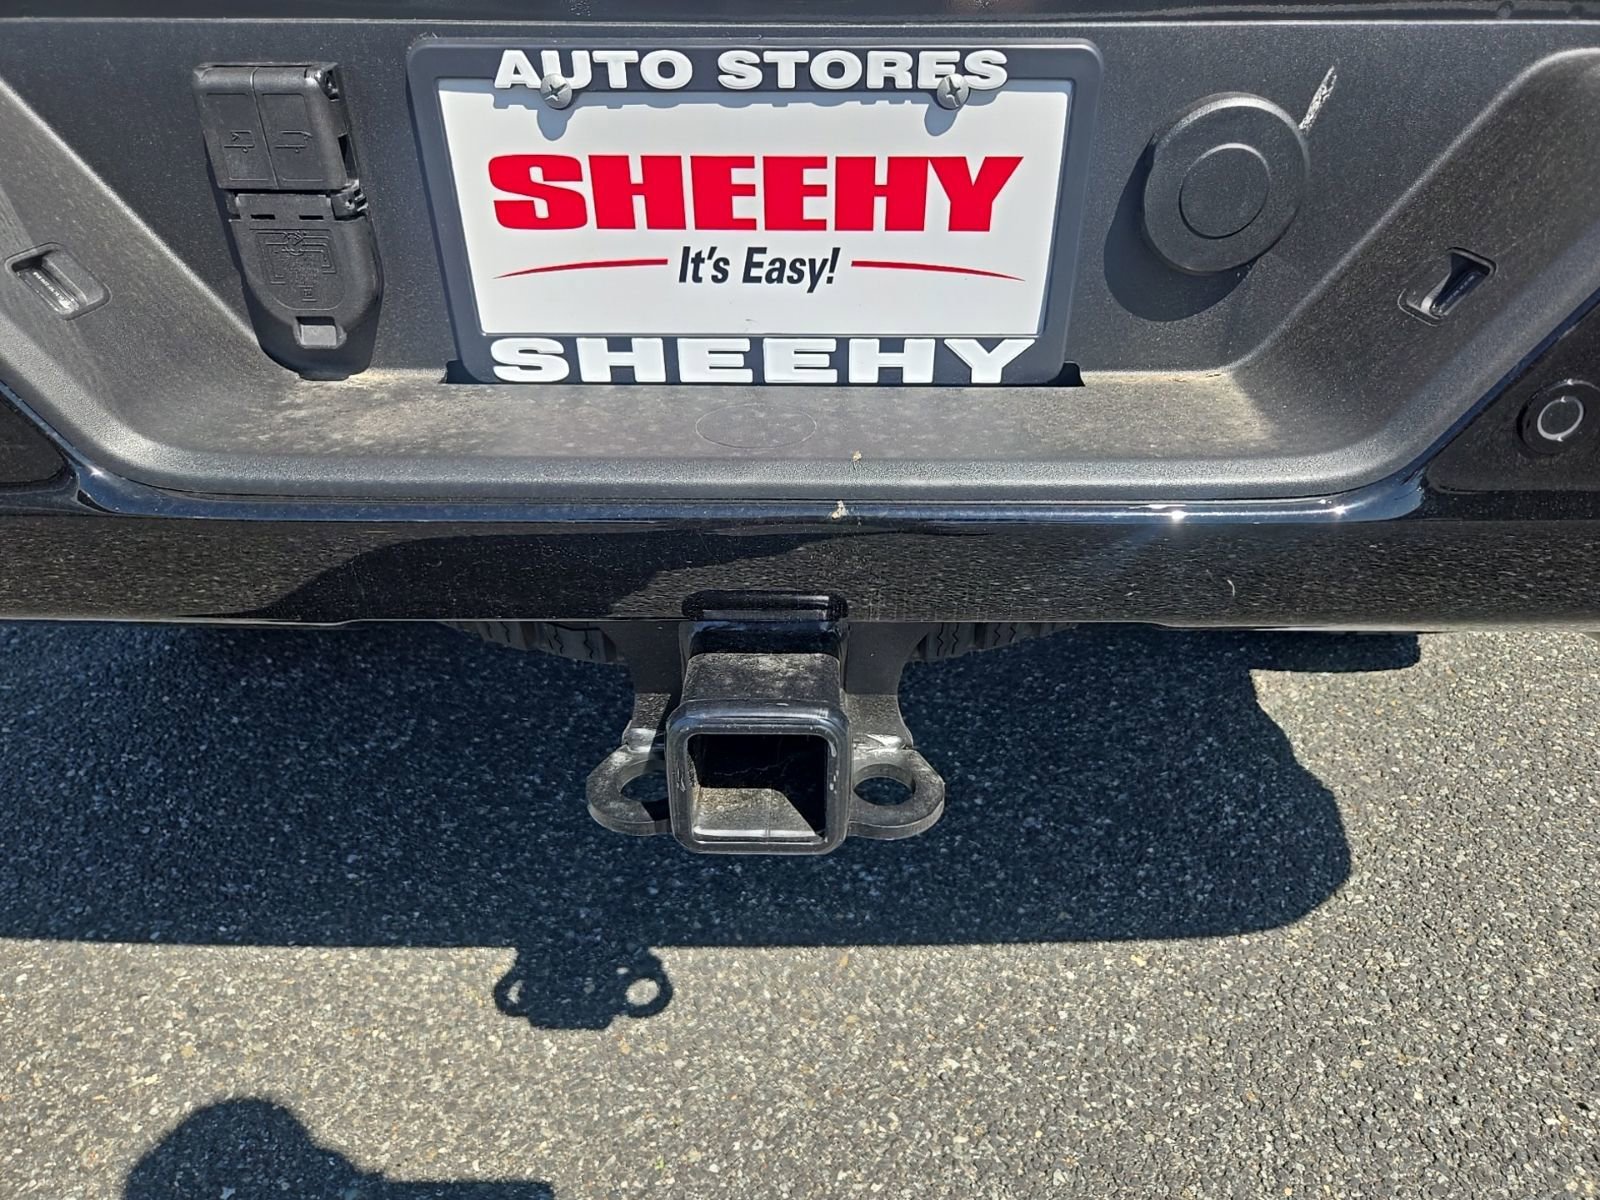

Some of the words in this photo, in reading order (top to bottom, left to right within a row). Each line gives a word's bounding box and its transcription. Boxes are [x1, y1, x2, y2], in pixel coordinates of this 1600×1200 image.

[494, 49, 693, 90] AUTO
[717, 49, 1008, 90] STORES
[488, 154, 1024, 232] SHEEHY
[679, 246, 730, 284] It's
[742, 247, 841, 294] Easy!
[490, 337, 1035, 383] SHEEHY
